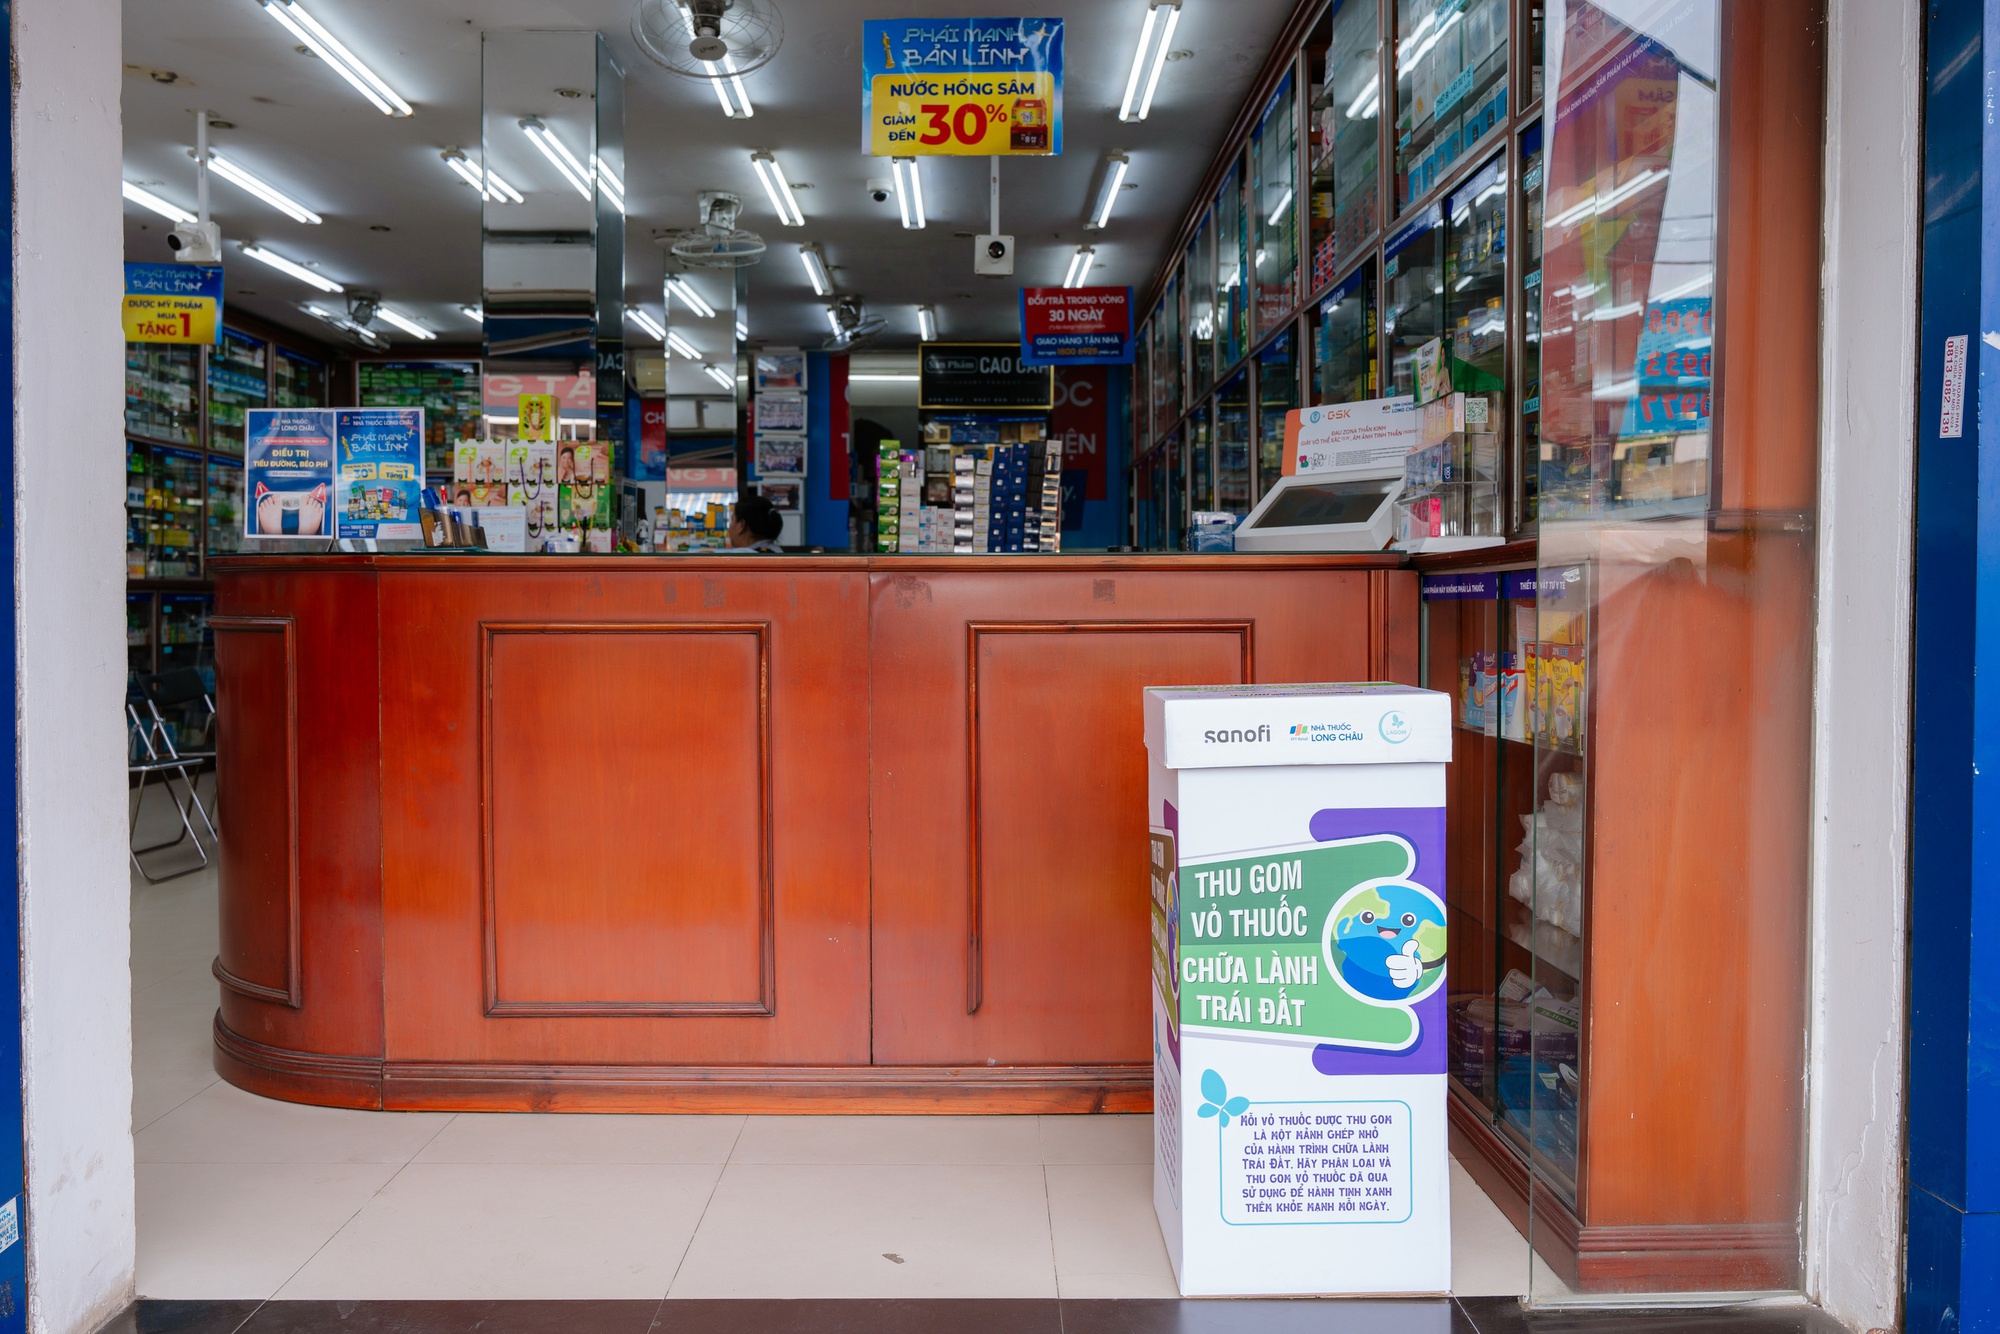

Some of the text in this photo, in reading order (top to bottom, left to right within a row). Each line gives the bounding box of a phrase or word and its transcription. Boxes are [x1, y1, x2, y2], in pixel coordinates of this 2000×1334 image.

[902, 24, 1028, 44] PHÁI MẠNH
[902, 43, 1029, 67] BẢN LĨNH
[890, 78, 1035, 97] NƯỚC HỒNG SÂM
[882, 111, 916, 126] GIẢM
[919, 103, 1008, 146] 30%
[888, 128, 916, 141] ĐẾN
[1049, 305, 1105, 322] 30 NGÀY
[137, 312, 190, 339] TẶNG 1
[1036, 334, 1119, 347] GIAO HÀNG TẬN NHÀ
[979, 356, 1012, 374] CAO
[1327, 408, 1352, 420] GSK
[1204, 724, 1271, 744] sanofi
[1310, 722, 1352, 732] NHÀ THUỐC
[1311, 731, 1364, 742] LONG CHÂU
[1194, 867, 1242, 899] THU
[1249, 859, 1303, 894] GOM
[1190, 903, 1224, 939] VỎ
[1228, 894, 1309, 937] THUỐC
[1182, 951, 1249, 984] CHỮA
[1255, 950, 1318, 986] LÀNH
[1196, 987, 1306, 1027] TRÁI ĐẤT
[1240, 1111, 1393, 1127] MỖI VỎ THUỐC ĐƯỢC THU GOM
[1253, 1125, 1379, 1141] LÀ MỘT MẢNH GHÉP NHỎ
[1243, 1141, 1390, 1155] CỦA HÀNH TRÌNH CHỮA LÀNH
[1241, 1156, 1392, 1170] TRÁI ĐẤT. HÃY PHÂN LOẠI VÀ
[1245, 1168, 1388, 1184] THU GOM VỎ THUỐC ĐÃ QUA
[1241, 1183, 1393, 1200] SỬ DỤNG ĐỂ HÀNH TINH XANH
[1245, 1197, 1390, 1214] THÊM KHỎE MẠNH MỖI NGÀY.
